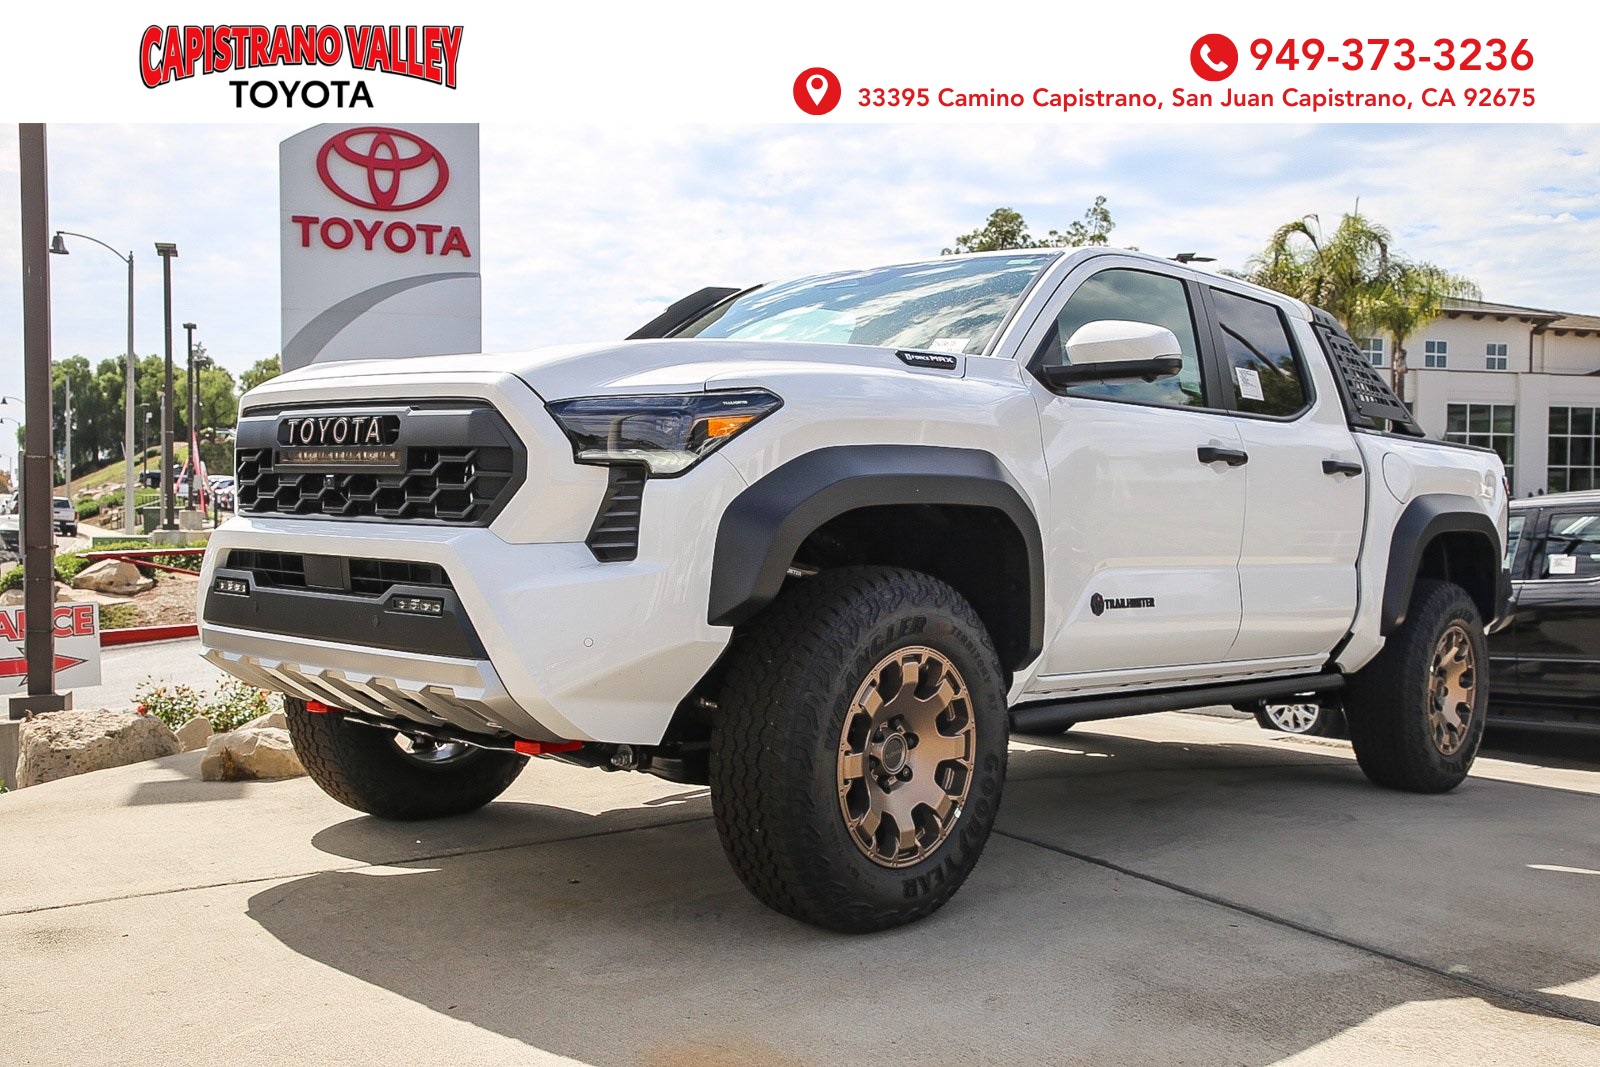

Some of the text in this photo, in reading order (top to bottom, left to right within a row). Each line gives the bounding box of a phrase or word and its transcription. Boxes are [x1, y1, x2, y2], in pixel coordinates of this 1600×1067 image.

[292, 215, 471, 258] TOYOTA
[288, 416, 383, 444] TOYOTA
[901, 752, 999, 899] GOODYEAR
